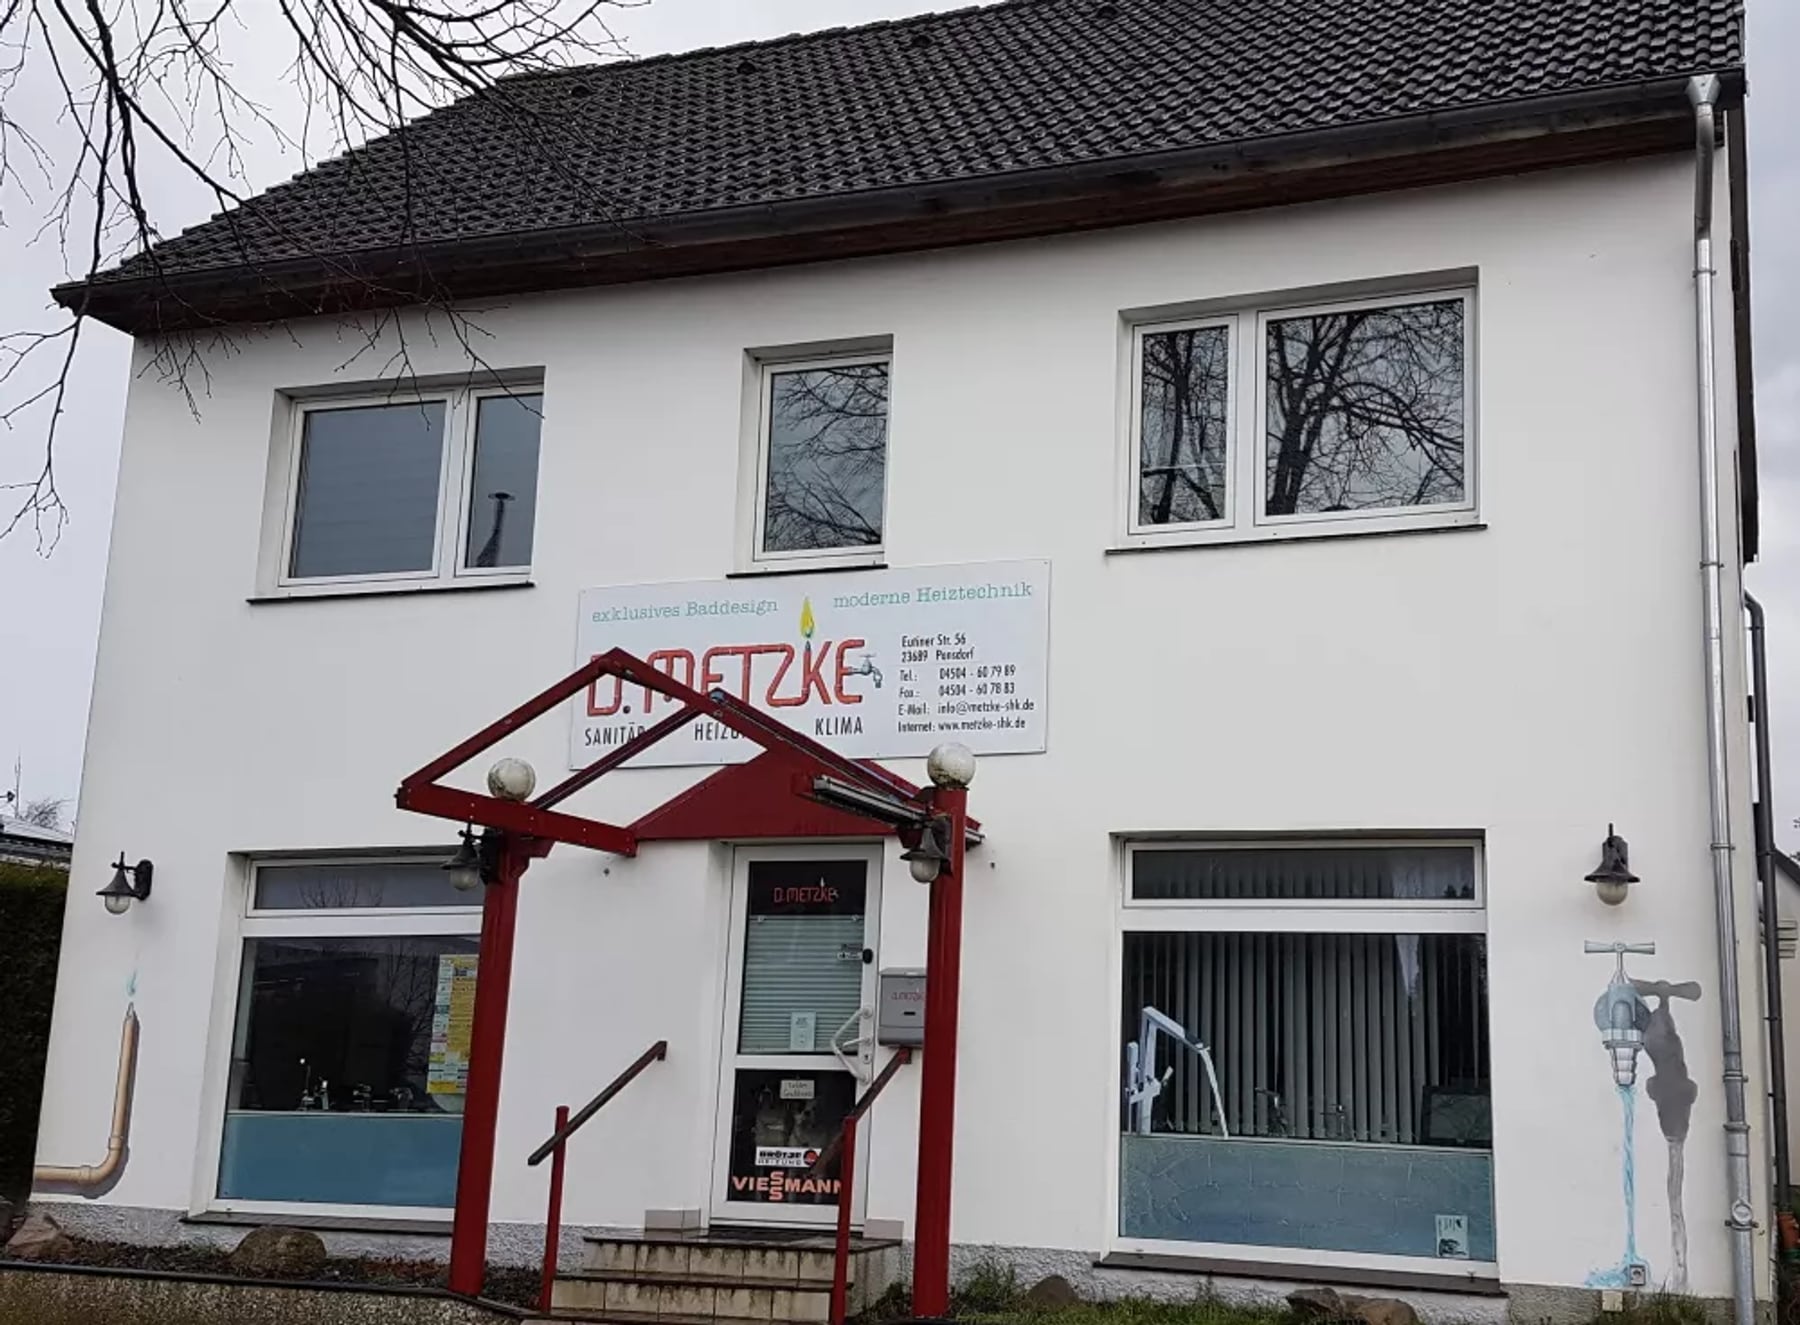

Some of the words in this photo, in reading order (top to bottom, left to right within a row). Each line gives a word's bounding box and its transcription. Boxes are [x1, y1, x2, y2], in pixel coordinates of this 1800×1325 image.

[833, 589, 911, 608] moderne
[916, 582, 1032, 603] Heiztechnik
[592, 604, 680, 622] exklusives
[685, 599, 778, 617] Baddesign
[902, 635, 934, 648] Eutiner
[937, 633, 951, 646] Str.
[954, 632, 967, 646] 56
[901, 649, 928, 663] 23689
[939, 666, 966, 680] 04504
[977, 665, 988, 678] 60
[990, 665, 1002, 678] 79
[1004, 664, 1016, 677] 89
[938, 684, 966, 697] 04504
[976, 682, 988, 695] 60
[990, 682, 1002, 695] 78
[1004, 681, 1015, 694] 83
[898, 702, 930, 716] E-Mail:
[937, 698, 1034, 715] info@metzke-shk.de
[815, 716, 863, 736] KLIMA
[898, 721, 935, 733] Internet:
[938, 716, 1026, 731] www.metzke-shk.de
